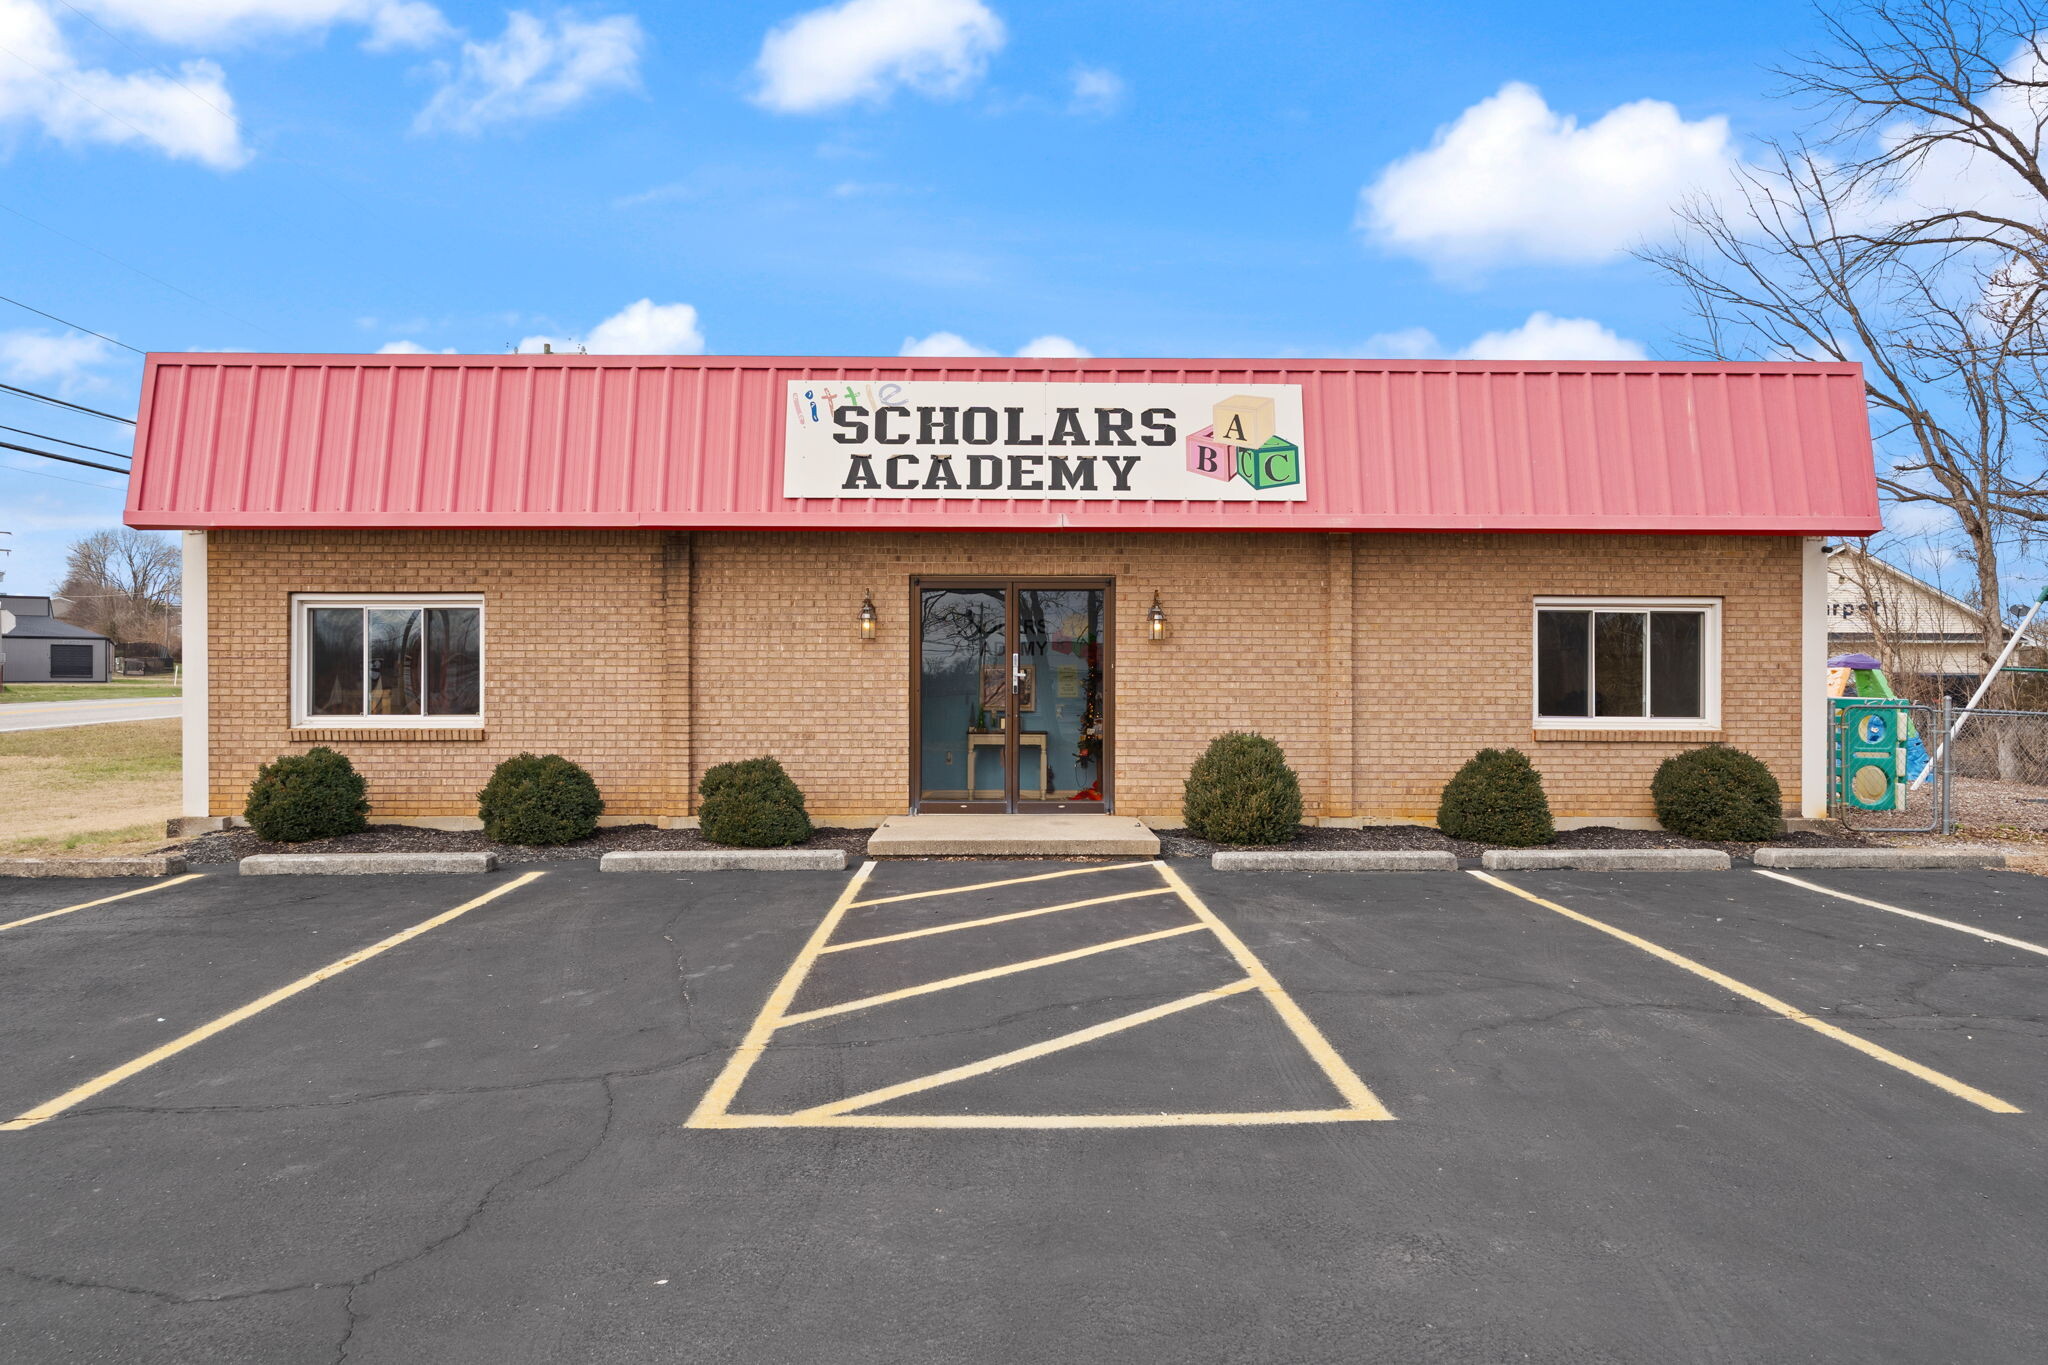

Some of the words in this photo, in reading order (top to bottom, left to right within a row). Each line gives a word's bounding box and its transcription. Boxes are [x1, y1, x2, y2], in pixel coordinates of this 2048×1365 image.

[793, 383, 909, 424] little
[833, 405, 1176, 447] SCHOLARS
[1223, 413, 1248, 441] A
[841, 454, 1141, 491] ACADEMY
[1196, 444, 1218, 473] B
[1264, 453, 1290, 482] C
[1826, 601, 1880, 619] rpet
